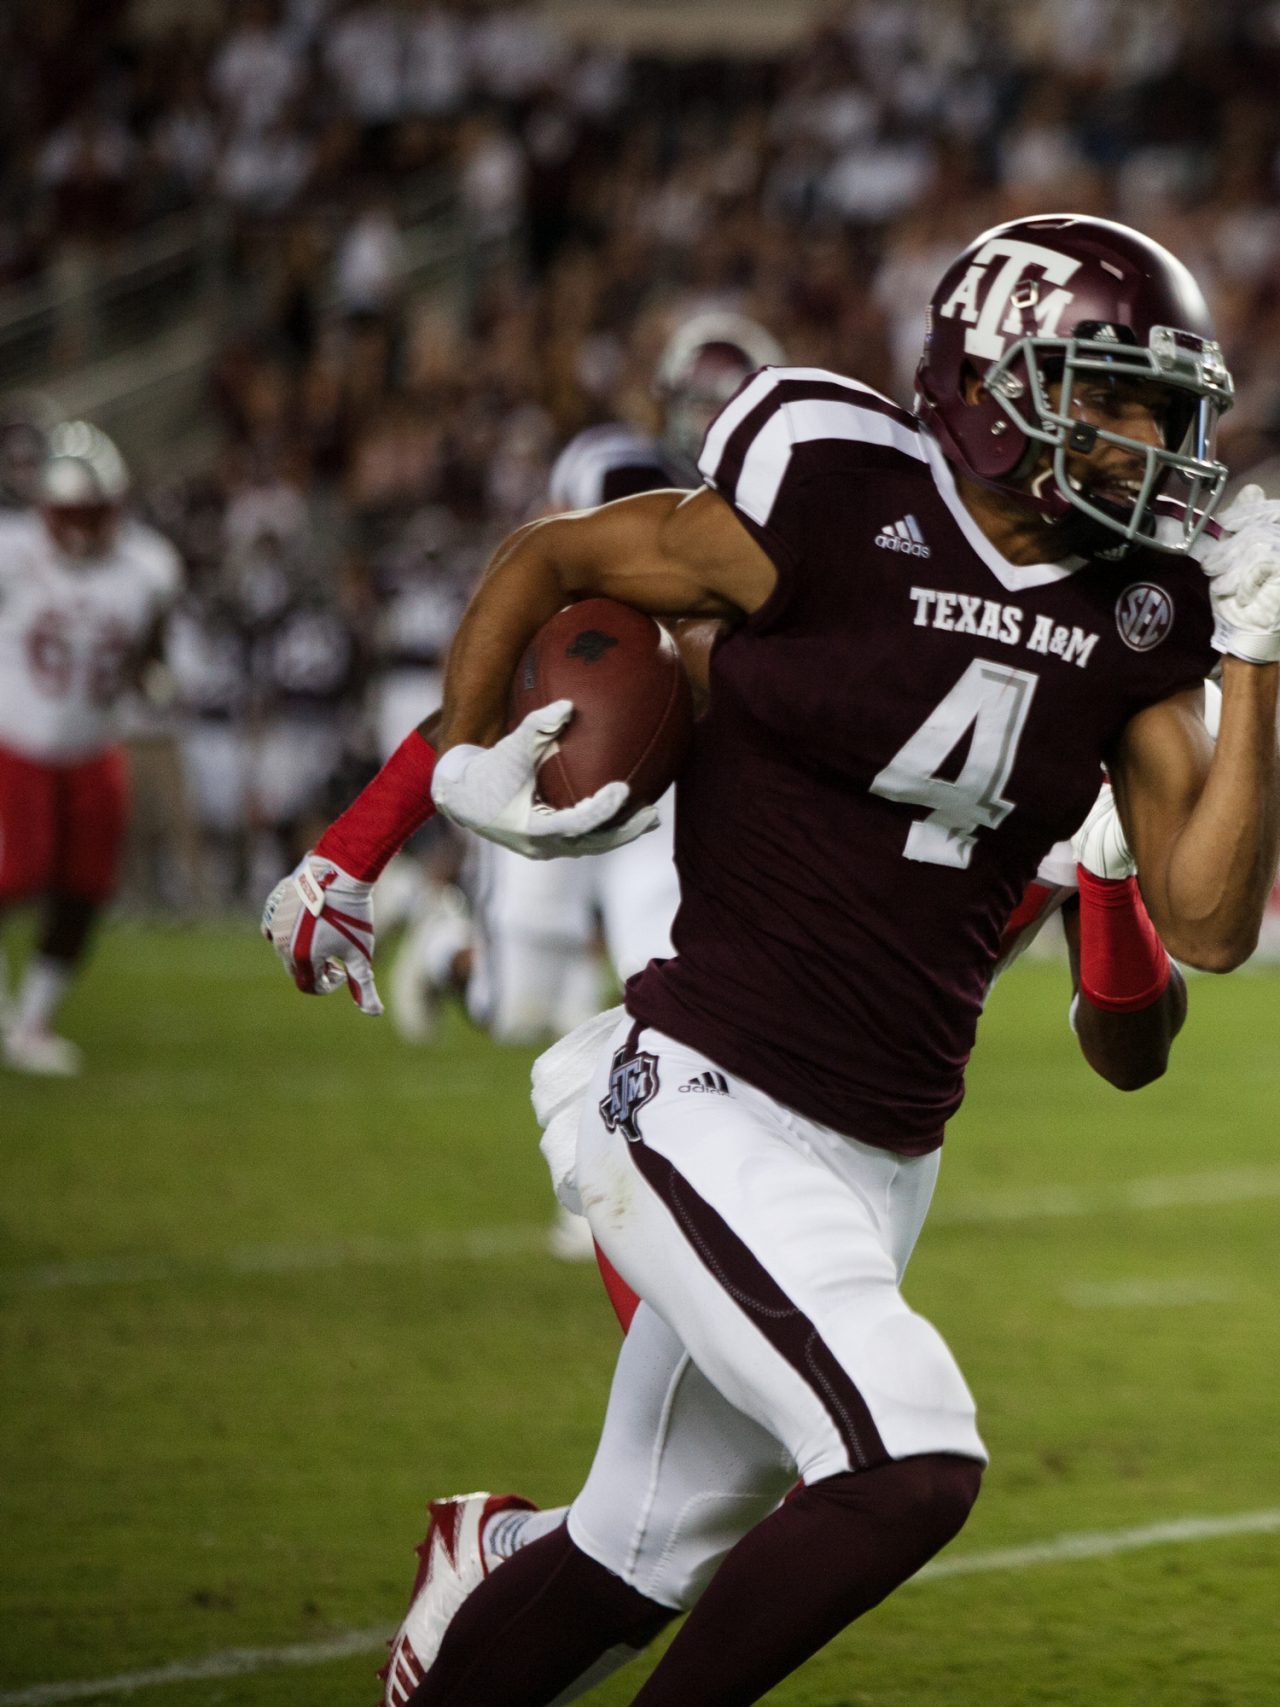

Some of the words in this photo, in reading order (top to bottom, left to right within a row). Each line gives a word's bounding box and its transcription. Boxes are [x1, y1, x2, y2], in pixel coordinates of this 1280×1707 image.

[874, 533, 931, 560] adidas
[910, 586, 1023, 647] TEXAS
[1026, 614, 1100, 669] A&M
[1121, 587, 1169, 646] SEC
[868, 657, 1040, 870] 4
